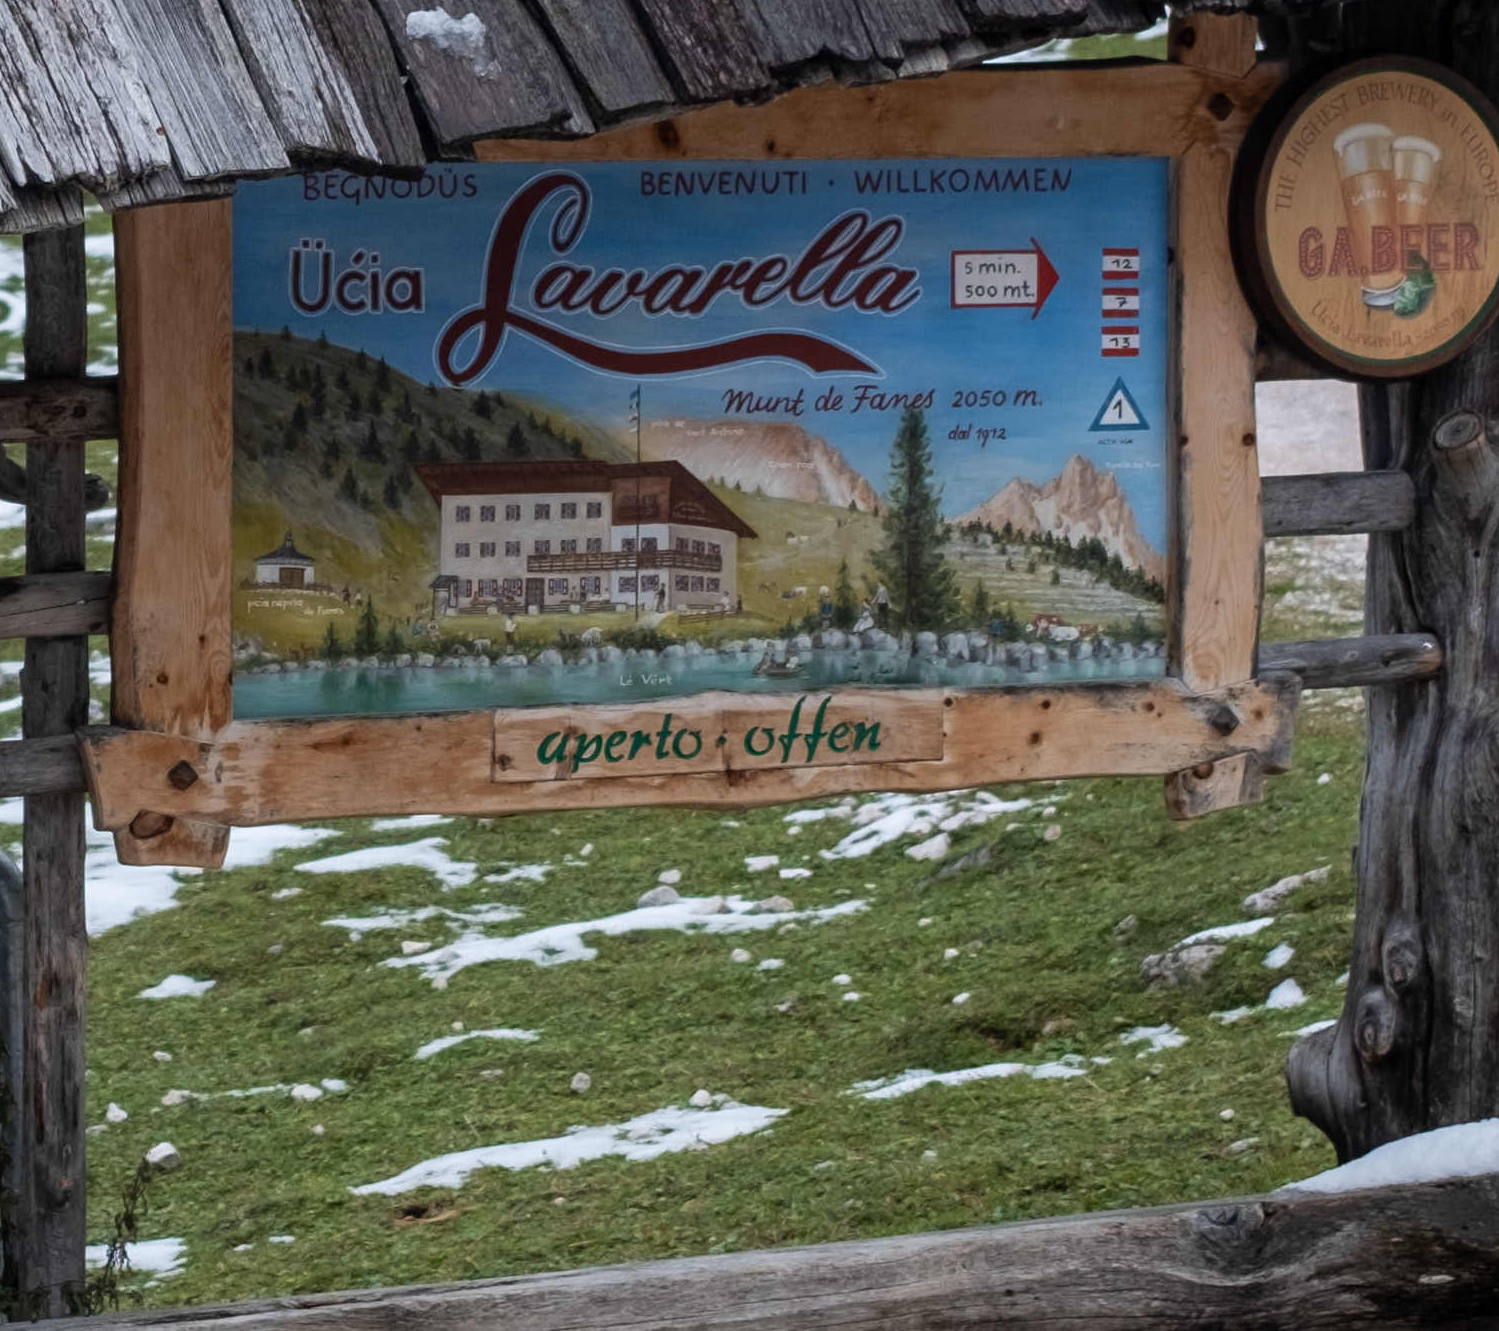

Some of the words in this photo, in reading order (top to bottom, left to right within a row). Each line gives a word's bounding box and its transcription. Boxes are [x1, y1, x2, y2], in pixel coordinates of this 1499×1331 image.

[1274, 170, 1296, 213] THE
[1286, 91, 1351, 168] HIGHEST
[1355, 81, 1439, 112] BREWERY
[1459, 122, 1499, 211] EUROPE
[640, 170, 807, 196] BENVENUTI
[854, 168, 1072, 194] WILLKOMMEN
[965, 261, 973, 275] 5
[978, 256, 1022, 275] min.
[1110, 259, 1133, 270] 12
[434, 169, 923, 389] Lavarella
[965, 284, 998, 298] 500
[1003, 280, 1035, 298] mt.
[1115, 297, 1128, 308] 7
[1109, 337, 1131, 349] 13
[721, 387, 805, 417] Munt
[814, 385, 844, 412] de
[850, 384, 936, 413] Fanes
[951, 389, 1007, 408] 2050
[1012, 389, 1044, 407] m.
[1112, 399, 1123, 420] 1
[947, 424, 972, 441] dal
[535, 713, 703, 772] aperto
[743, 695, 882, 763] offen
